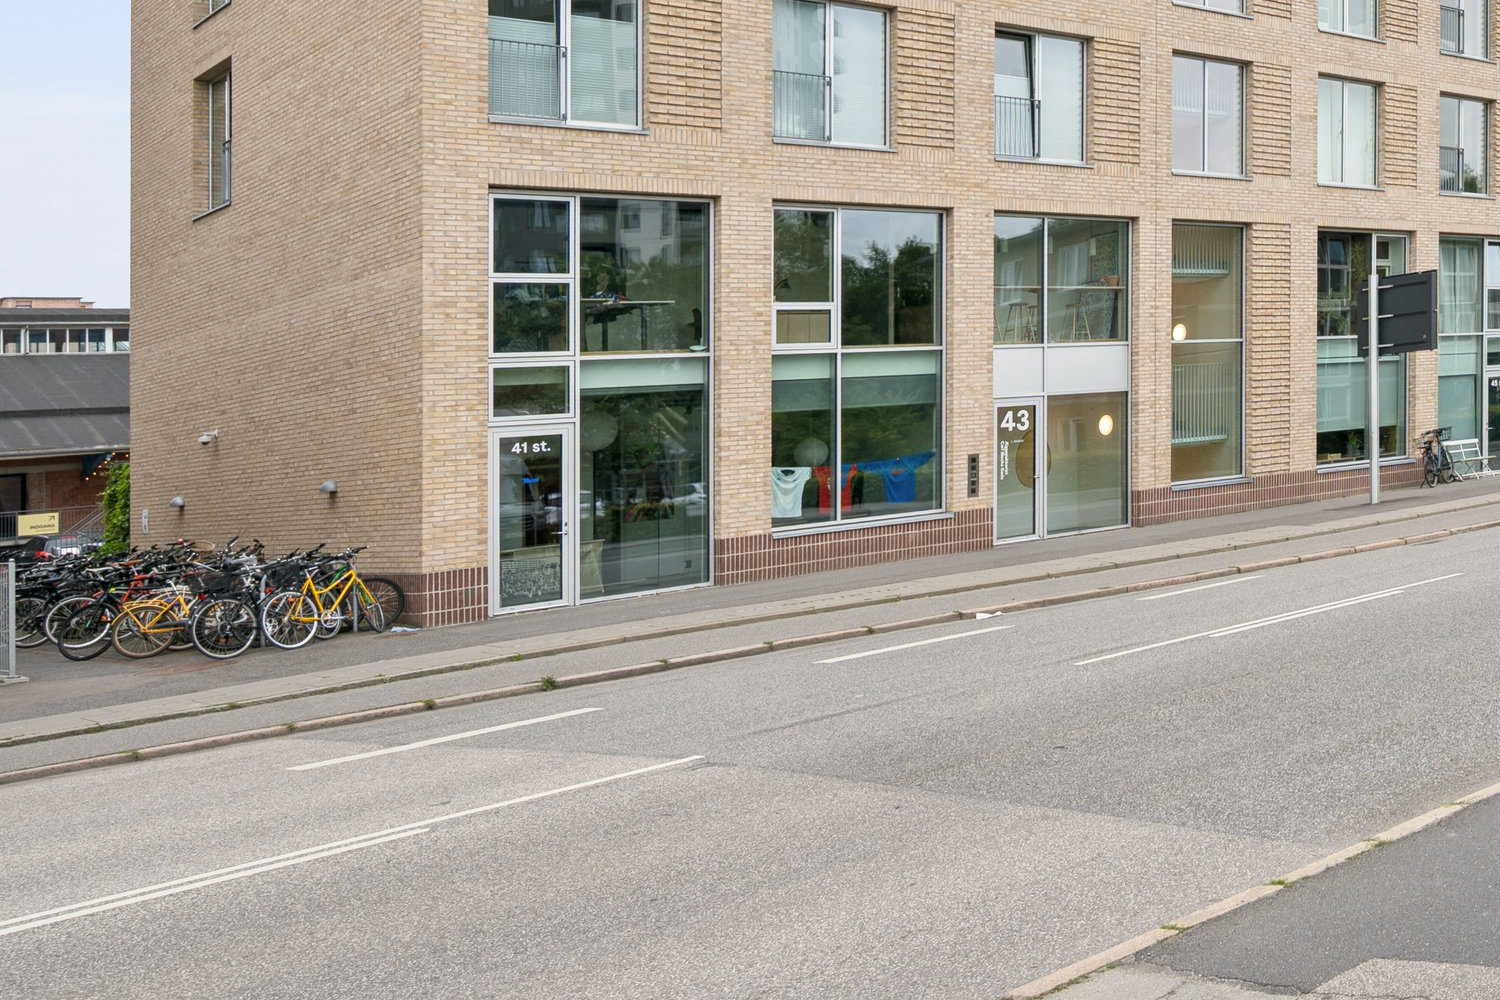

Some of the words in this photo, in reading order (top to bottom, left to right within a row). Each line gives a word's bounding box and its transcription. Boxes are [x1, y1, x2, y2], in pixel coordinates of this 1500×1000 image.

[1491, 379, 1498, 387] 45
[1000, 410, 1030, 431] 43
[511, 441, 528, 454] 41
[532, 440, 552, 453] st.
